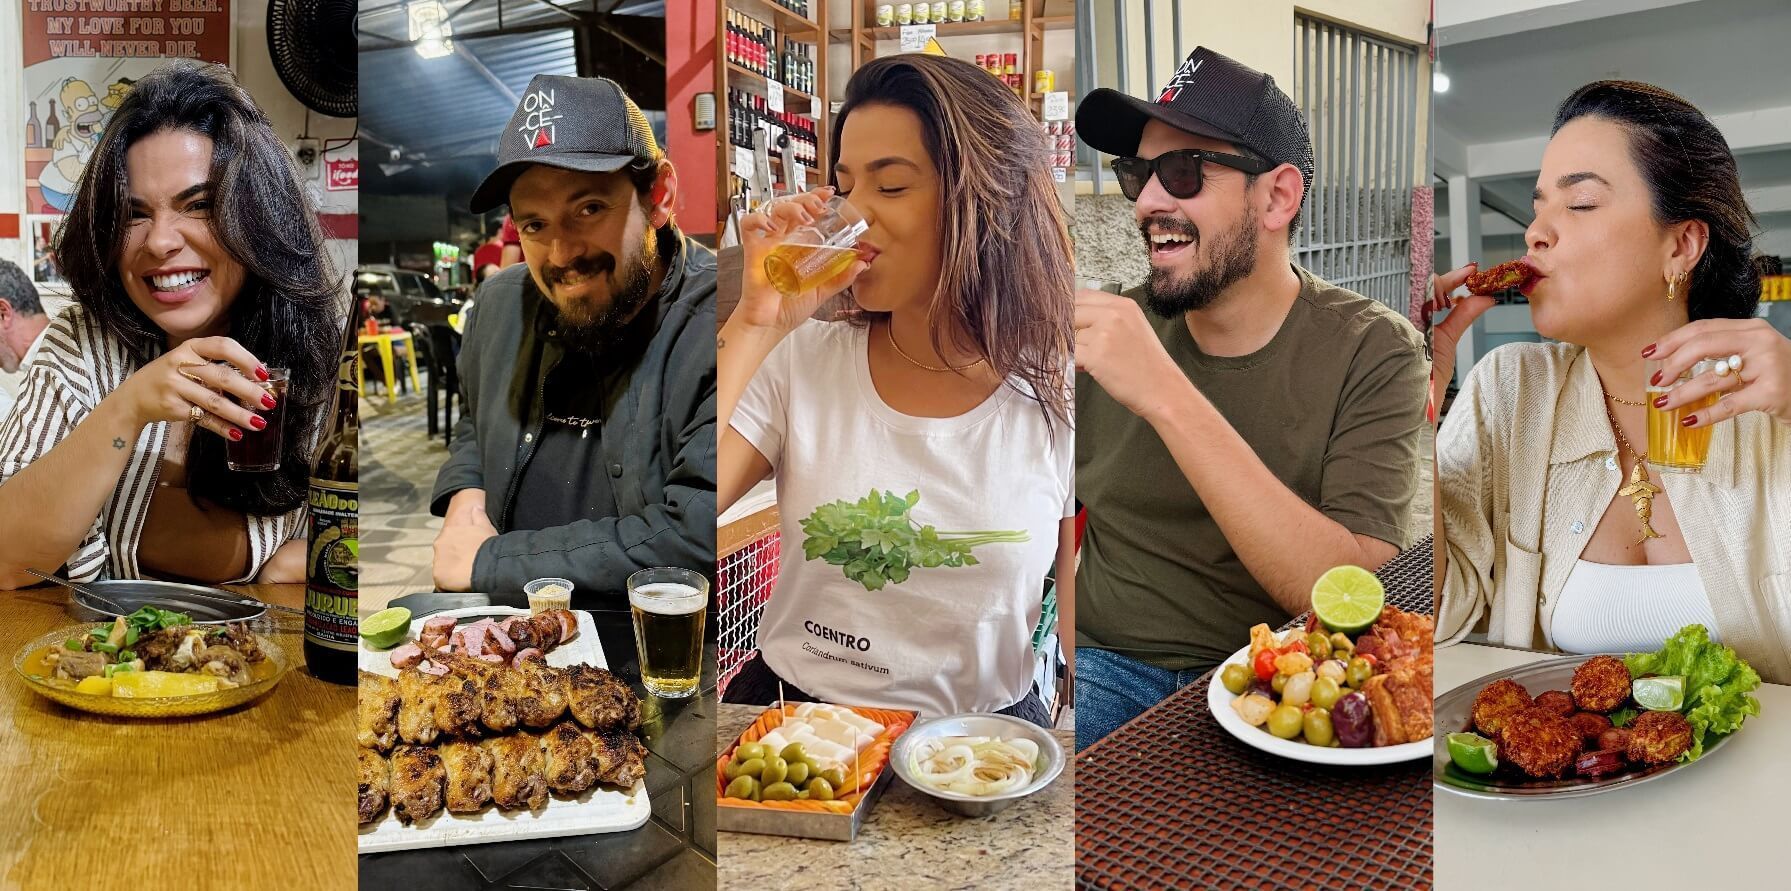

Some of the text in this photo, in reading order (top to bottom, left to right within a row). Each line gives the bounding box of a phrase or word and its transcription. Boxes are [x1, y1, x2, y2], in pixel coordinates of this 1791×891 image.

[47, 17, 205, 35] MY LOVE FOR YOU
[49, 40, 201, 57] WILL NEVER DIE.
[524, 88, 555, 112] ON
[804, 620, 871, 652] COENTRO
[801, 641, 889, 675] Coriandrum sativum
